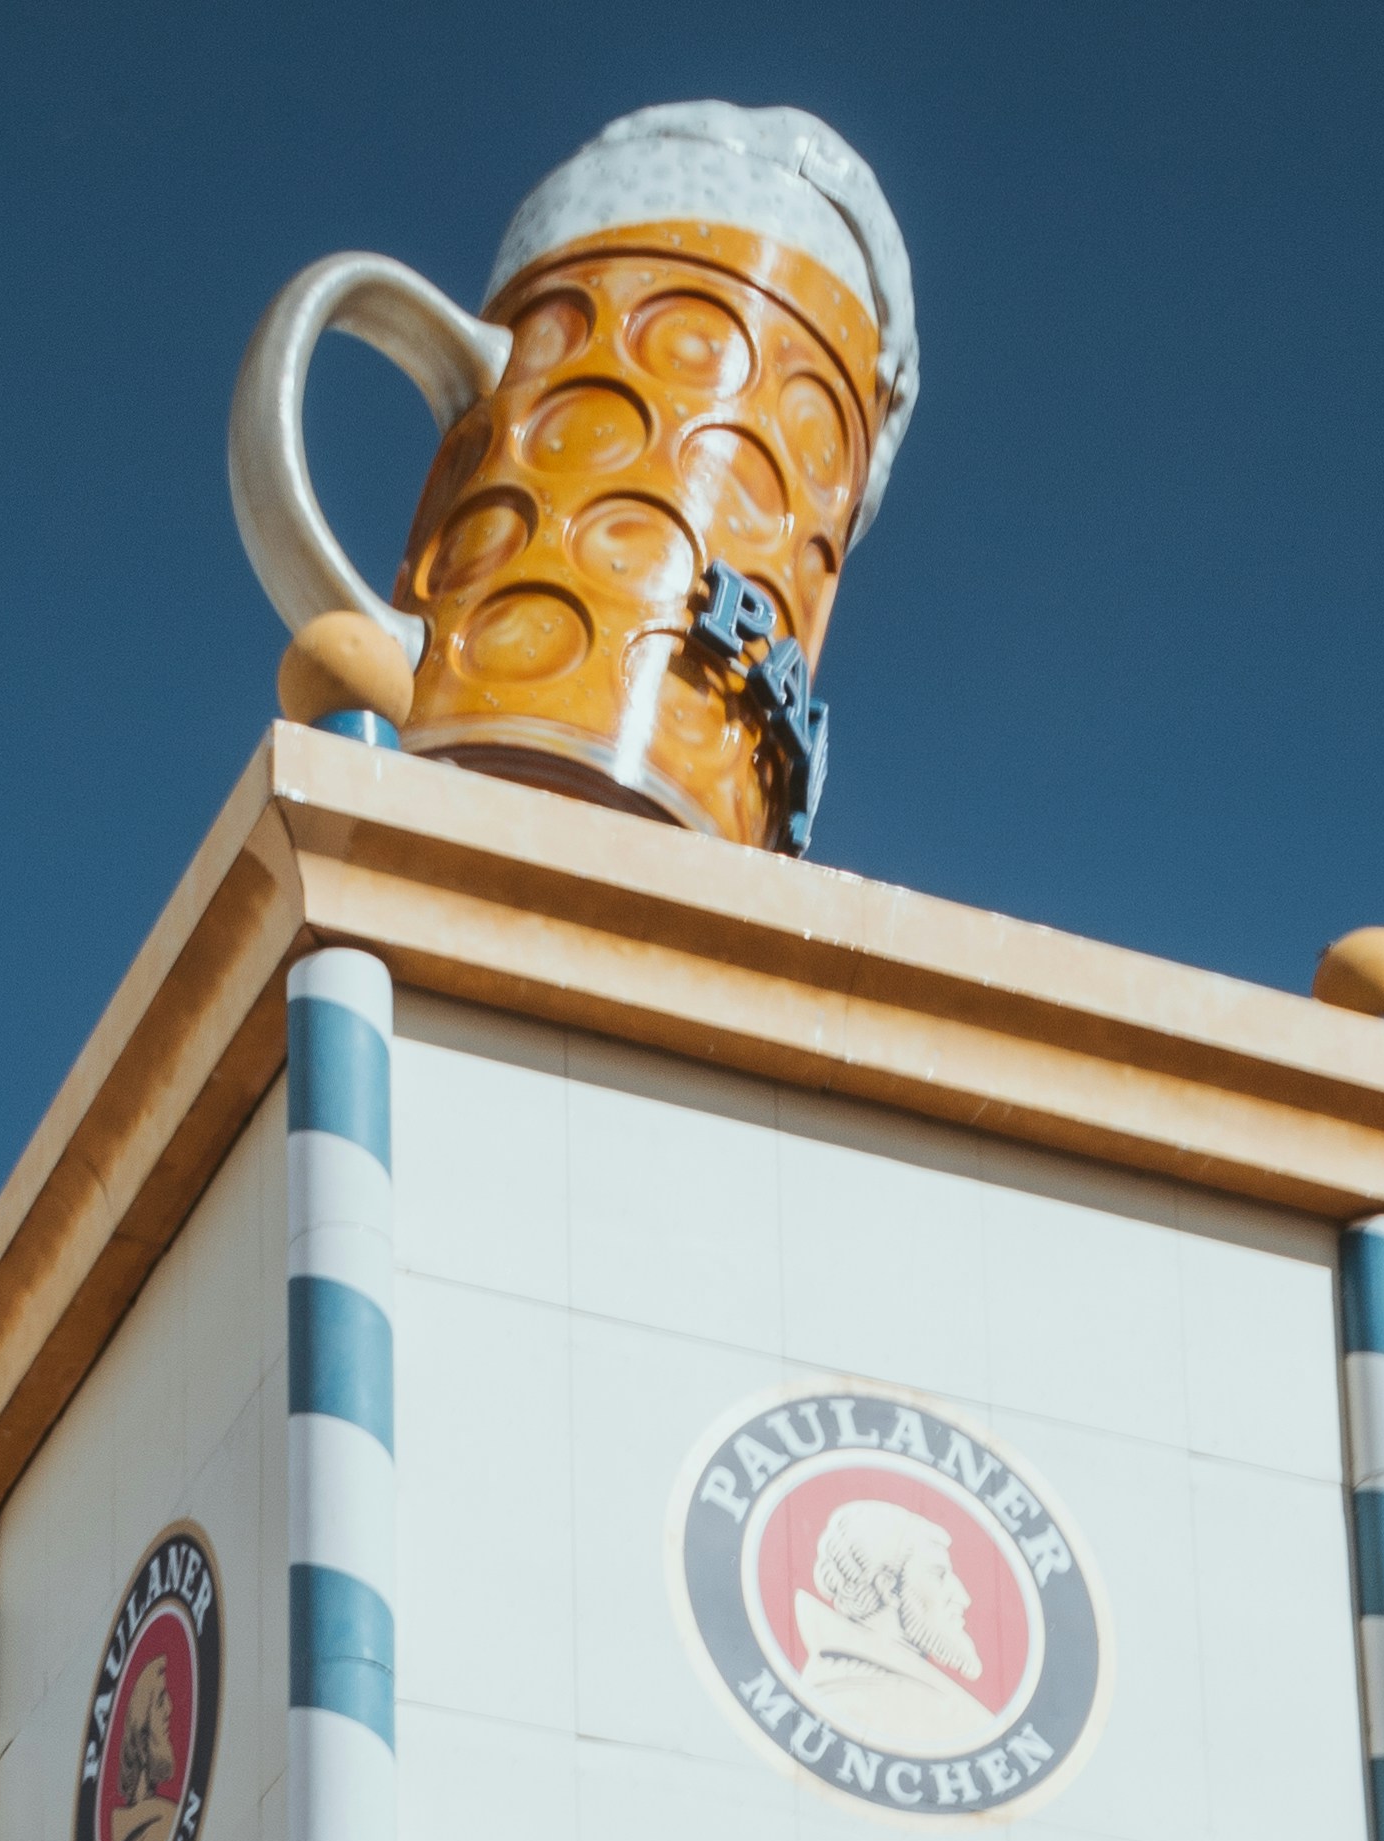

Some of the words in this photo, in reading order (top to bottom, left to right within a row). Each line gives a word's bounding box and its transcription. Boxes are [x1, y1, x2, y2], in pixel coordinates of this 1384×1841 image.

[700, 1397, 1074, 1588] PAULANER
[81, 1540, 212, 1785] PAULANER
[738, 1666, 1056, 1806] MÜNCHEN
